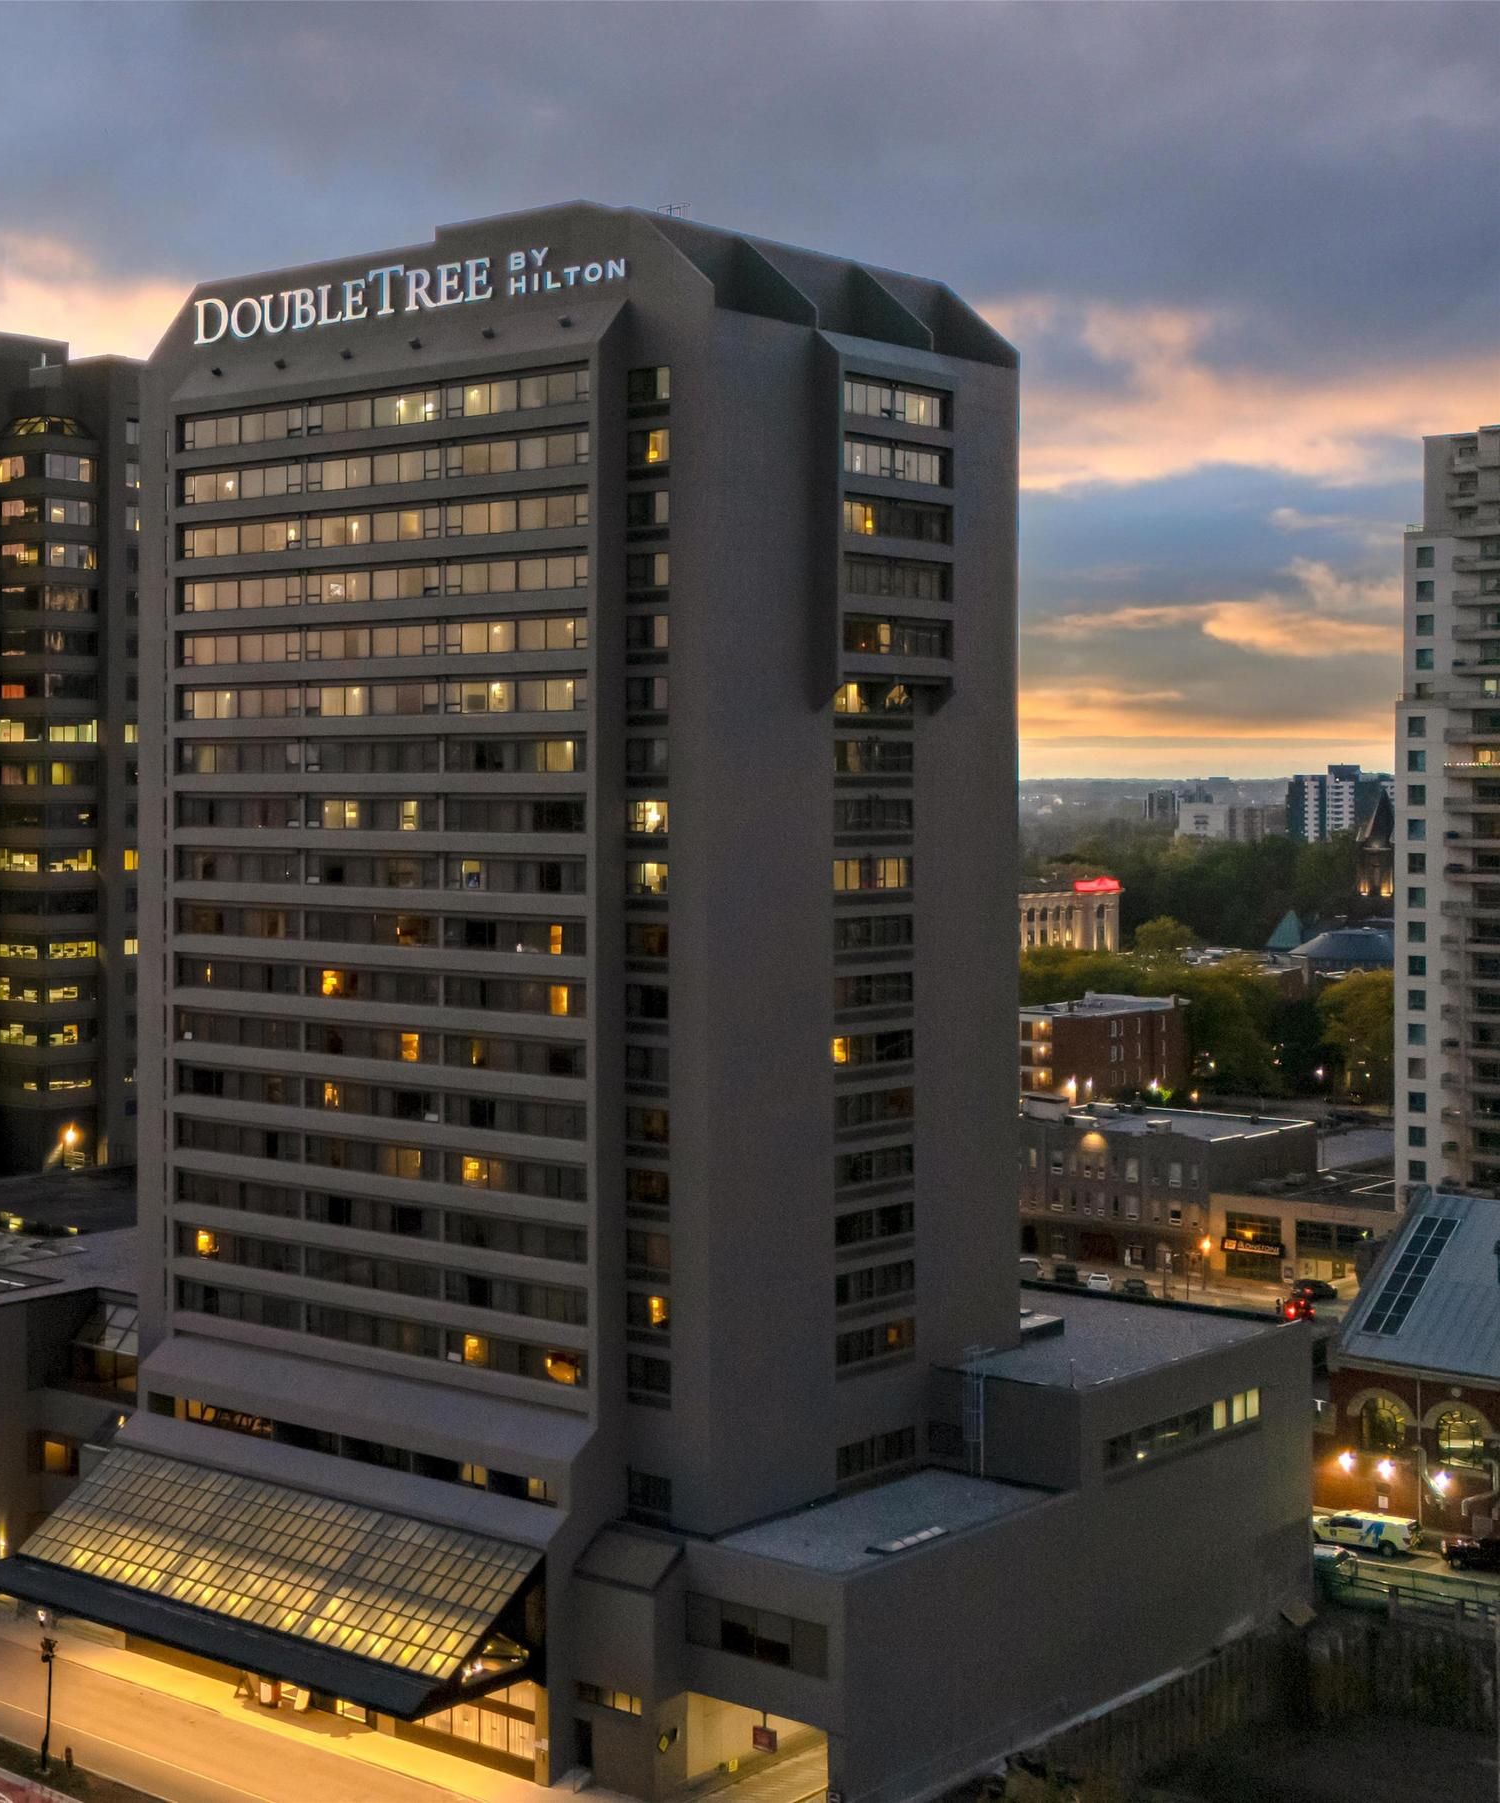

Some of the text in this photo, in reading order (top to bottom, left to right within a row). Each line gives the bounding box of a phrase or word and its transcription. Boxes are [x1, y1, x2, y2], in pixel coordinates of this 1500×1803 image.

[509, 247, 548, 270] BY
[509, 258, 625, 295] HILTON
[194, 257, 492, 345] DOUBLETREE
